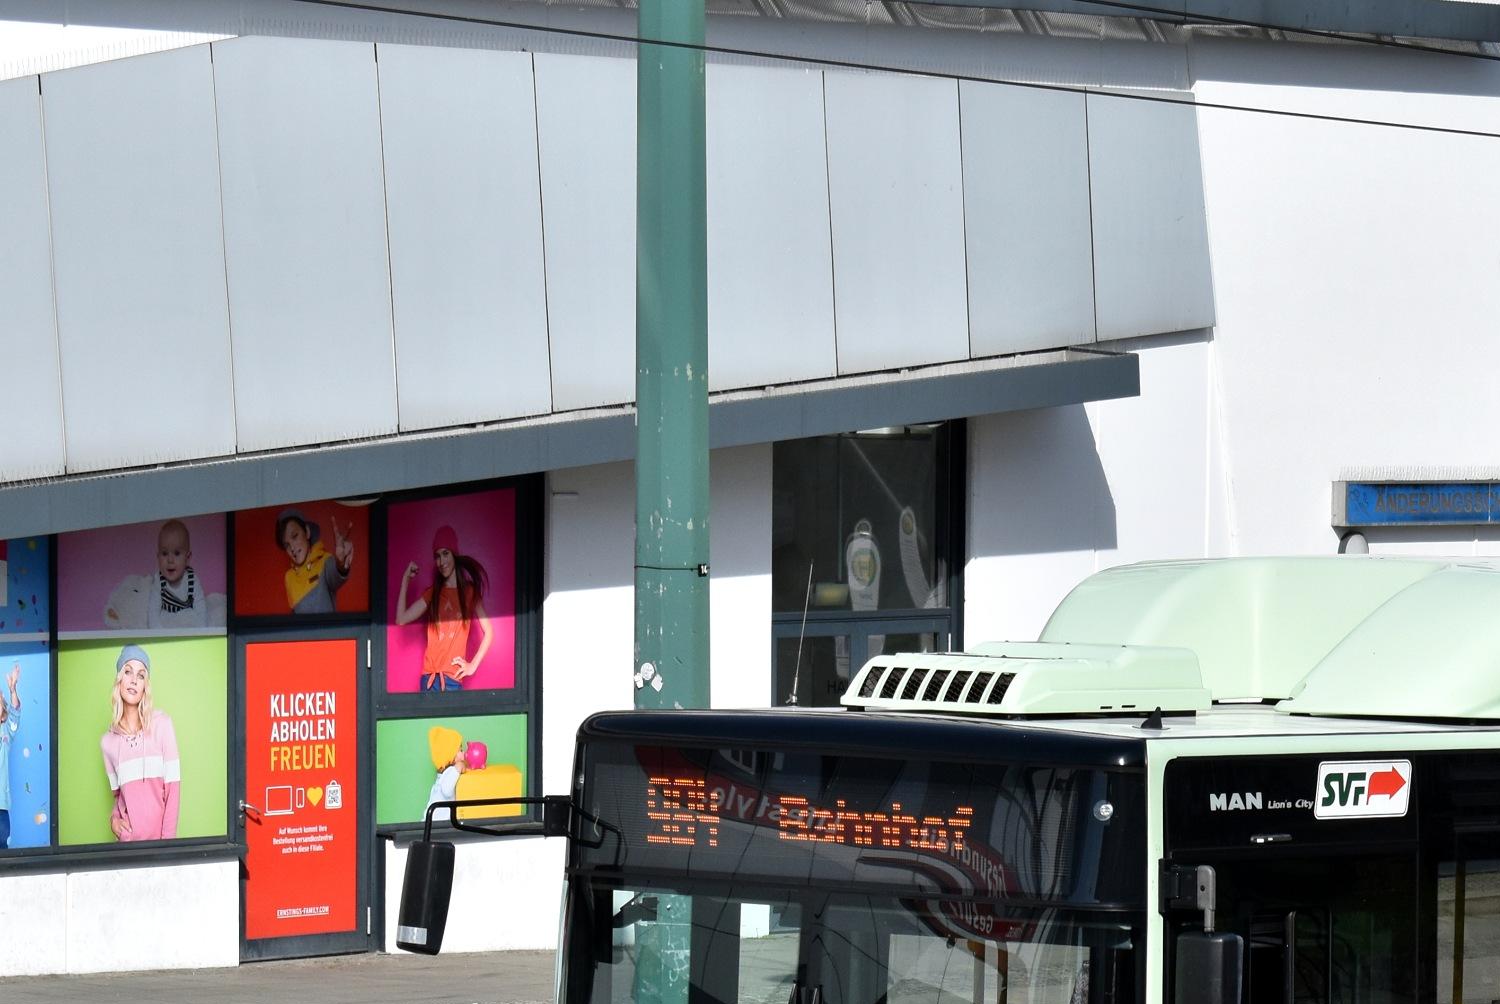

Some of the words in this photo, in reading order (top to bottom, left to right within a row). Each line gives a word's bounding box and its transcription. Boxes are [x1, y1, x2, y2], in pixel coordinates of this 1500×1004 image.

[270, 691, 336, 718] KLICKEN
[270, 718, 336, 743] ABHOLEN
[270, 743, 336, 772] FREUEN
[1209, 792, 1263, 811] MAN
[1267, 799, 1292, 809] Lion's
[1295, 798, 1315, 810] City
[1321, 772, 1367, 807] SVF
[778, 796, 974, 850] Bahnhof
